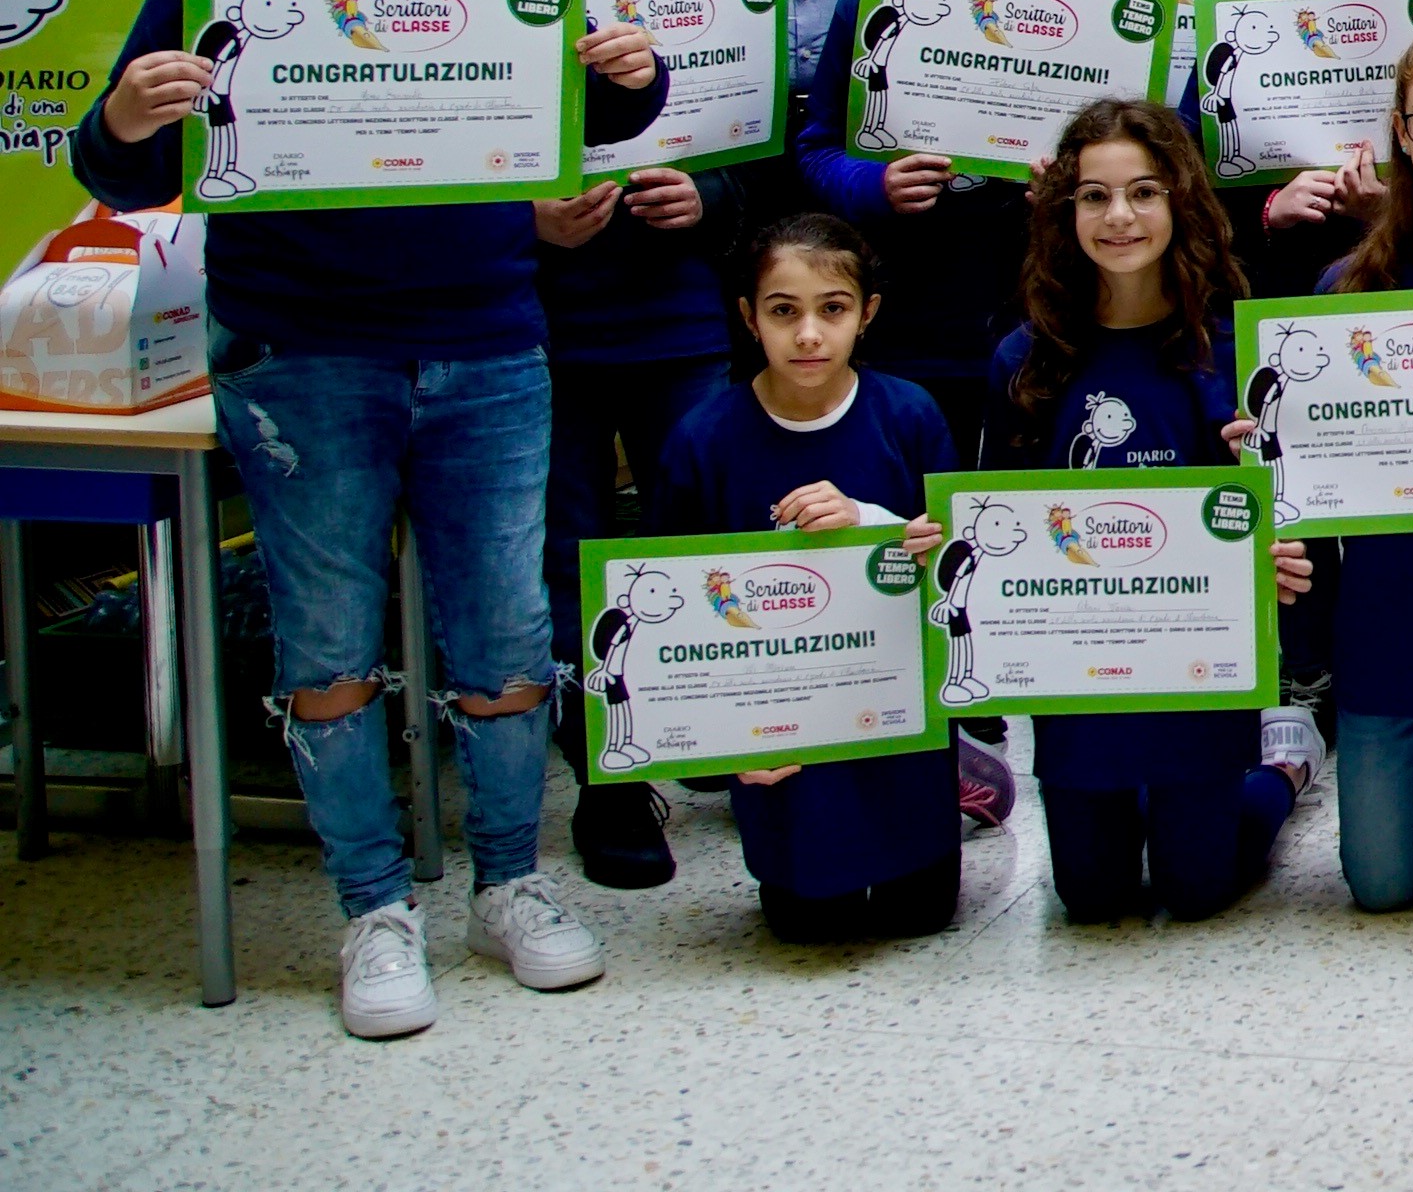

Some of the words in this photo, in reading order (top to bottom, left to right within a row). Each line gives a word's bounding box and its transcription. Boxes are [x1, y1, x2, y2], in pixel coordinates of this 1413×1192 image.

[518, 1, 558, 15] LIBERO
[1004, 2, 1066, 25] Scrittori
[662, 15, 704, 29] CLASSE
[1122, 9, 1155, 24] TEMPO
[1328, 14, 1377, 33] Scrittori
[374, 19, 388, 33] di
[392, 20, 450, 32] CLASSE
[1003, 20, 1014, 32] di
[1017, 22, 1064, 38] CLASSE
[1119, 19, 1152, 35] LIBERO
[1341, 32, 1378, 44] CLASSE
[272, 62, 512, 84] CONGRATULAZIONI!
[920, 47, 1109, 85] CONGRATULAZIONI!
[1260, 64, 1396, 88] CONGRATULAZIO
[4, 93, 24, 116] di
[31, 101, 66, 115] una
[383, 158, 424, 167] CONAD
[53, 283, 92, 296] BAG
[1387, 358, 1399, 371] di
[1126, 449, 1176, 463] DIARIO
[1213, 506, 1250, 519] TEMPO
[1085, 516, 1153, 535] Scrittori
[1212, 518, 1248, 530] LIBERO
[1086, 536, 1098, 549] di
[1101, 537, 1152, 549] CLASSE
[877, 562, 916, 573] TEMPO
[876, 574, 914, 584] LIBERO
[1001, 576, 1208, 597] CONGRATULAZIONI!
[745, 576, 815, 598] Scrittori
[746, 599, 759, 612] di
[762, 596, 815, 611] CLASSE
[658, 630, 875, 664] CONGRATULAZIONI!
